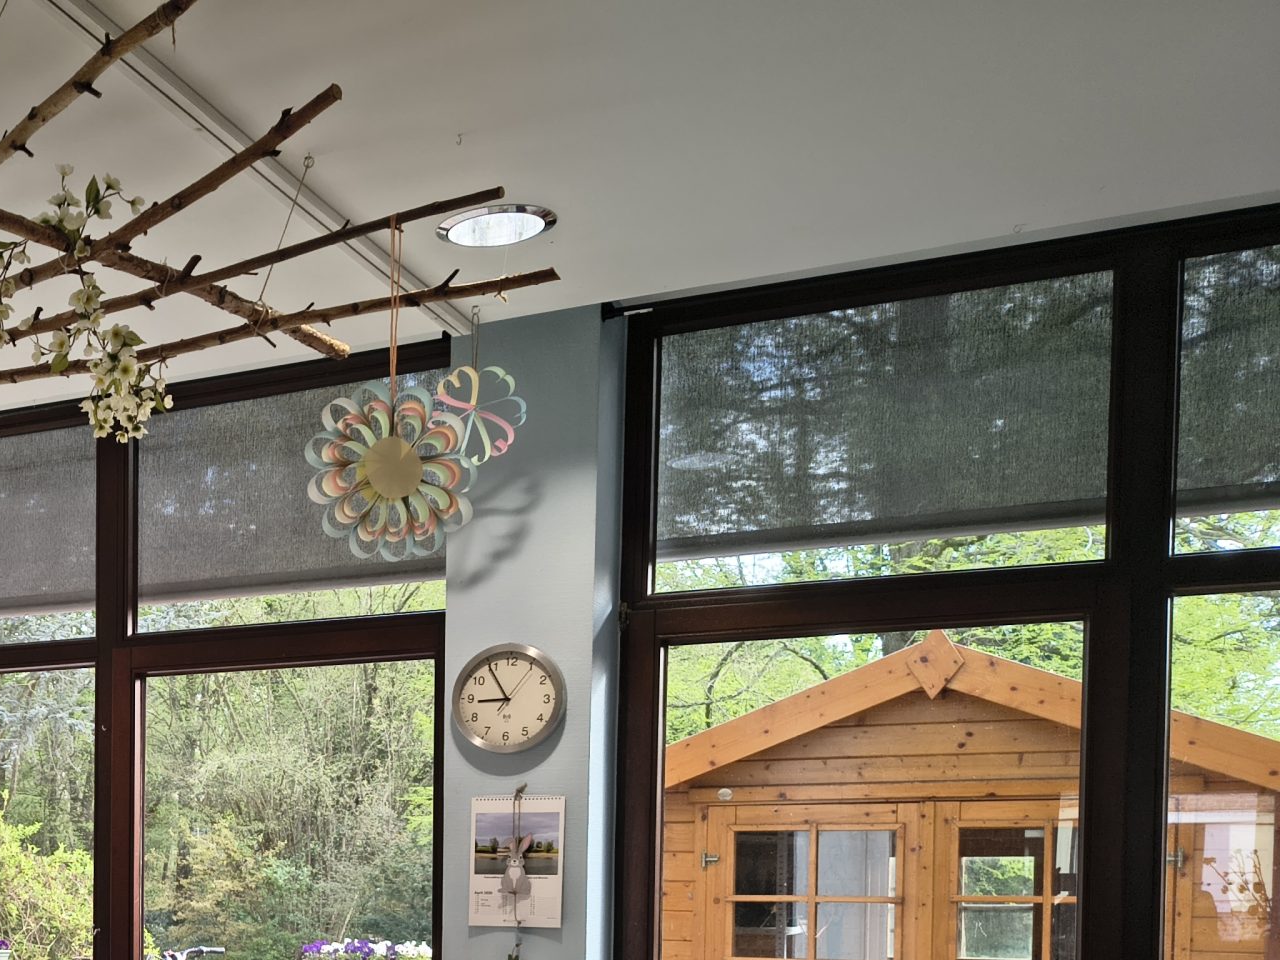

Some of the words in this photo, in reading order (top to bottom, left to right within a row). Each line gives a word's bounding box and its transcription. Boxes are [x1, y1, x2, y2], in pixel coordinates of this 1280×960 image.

[506, 656, 518, 667] 12
[529, 661, 534, 671] 1
[473, 676, 485, 686] 10
[539, 675, 547, 685] 2
[467, 694, 475, 703] 9
[543, 694, 551, 704] 3
[471, 712, 479, 722] 8
[536, 713, 544, 722] 4
[484, 726, 491, 736] 7
[502, 731, 510, 741] 6
[521, 726, 529, 736] 5
